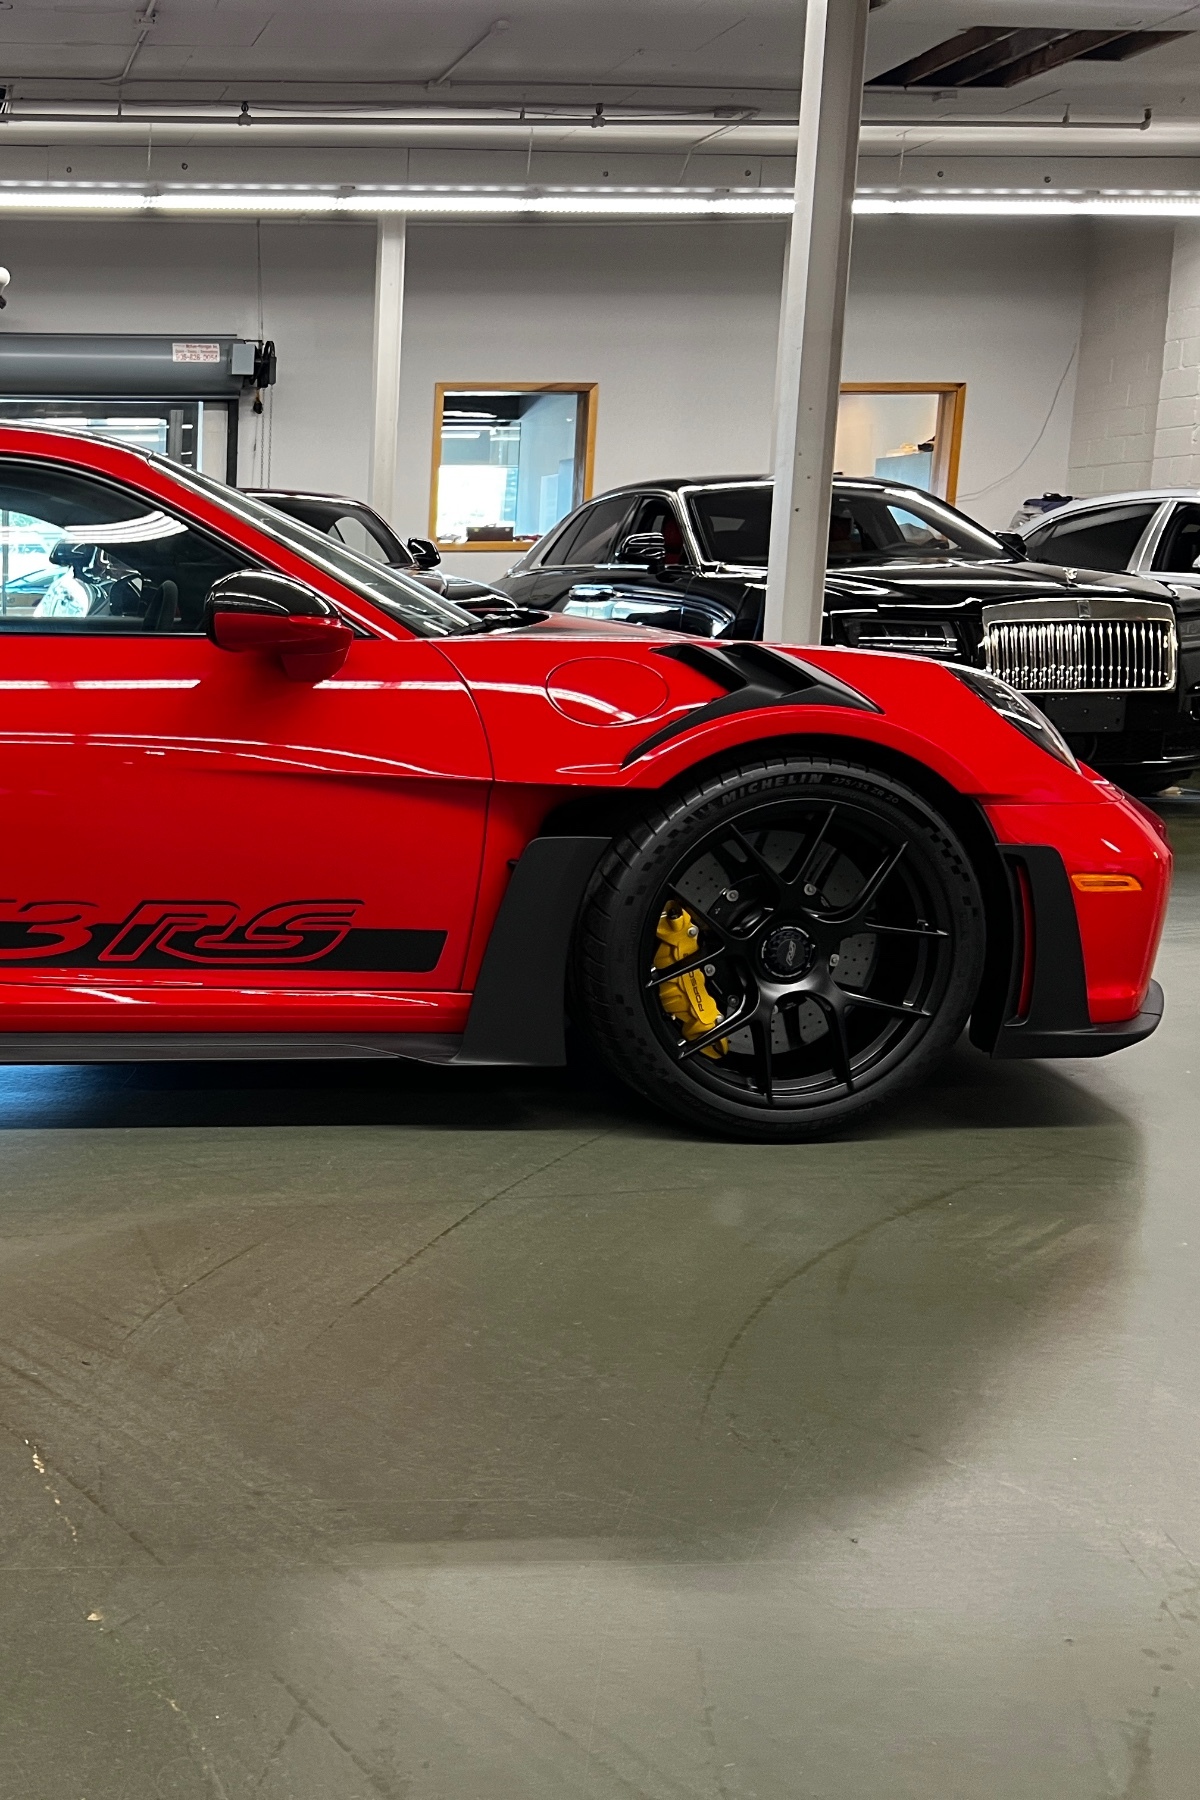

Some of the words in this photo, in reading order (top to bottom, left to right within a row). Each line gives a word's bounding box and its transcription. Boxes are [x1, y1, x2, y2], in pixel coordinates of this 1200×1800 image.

[721, 774, 823, 806] MICHELIN
[832, 777, 870, 793] 275/35
[870, 786, 884, 797] ZR
[885, 792, 899, 804] 20
